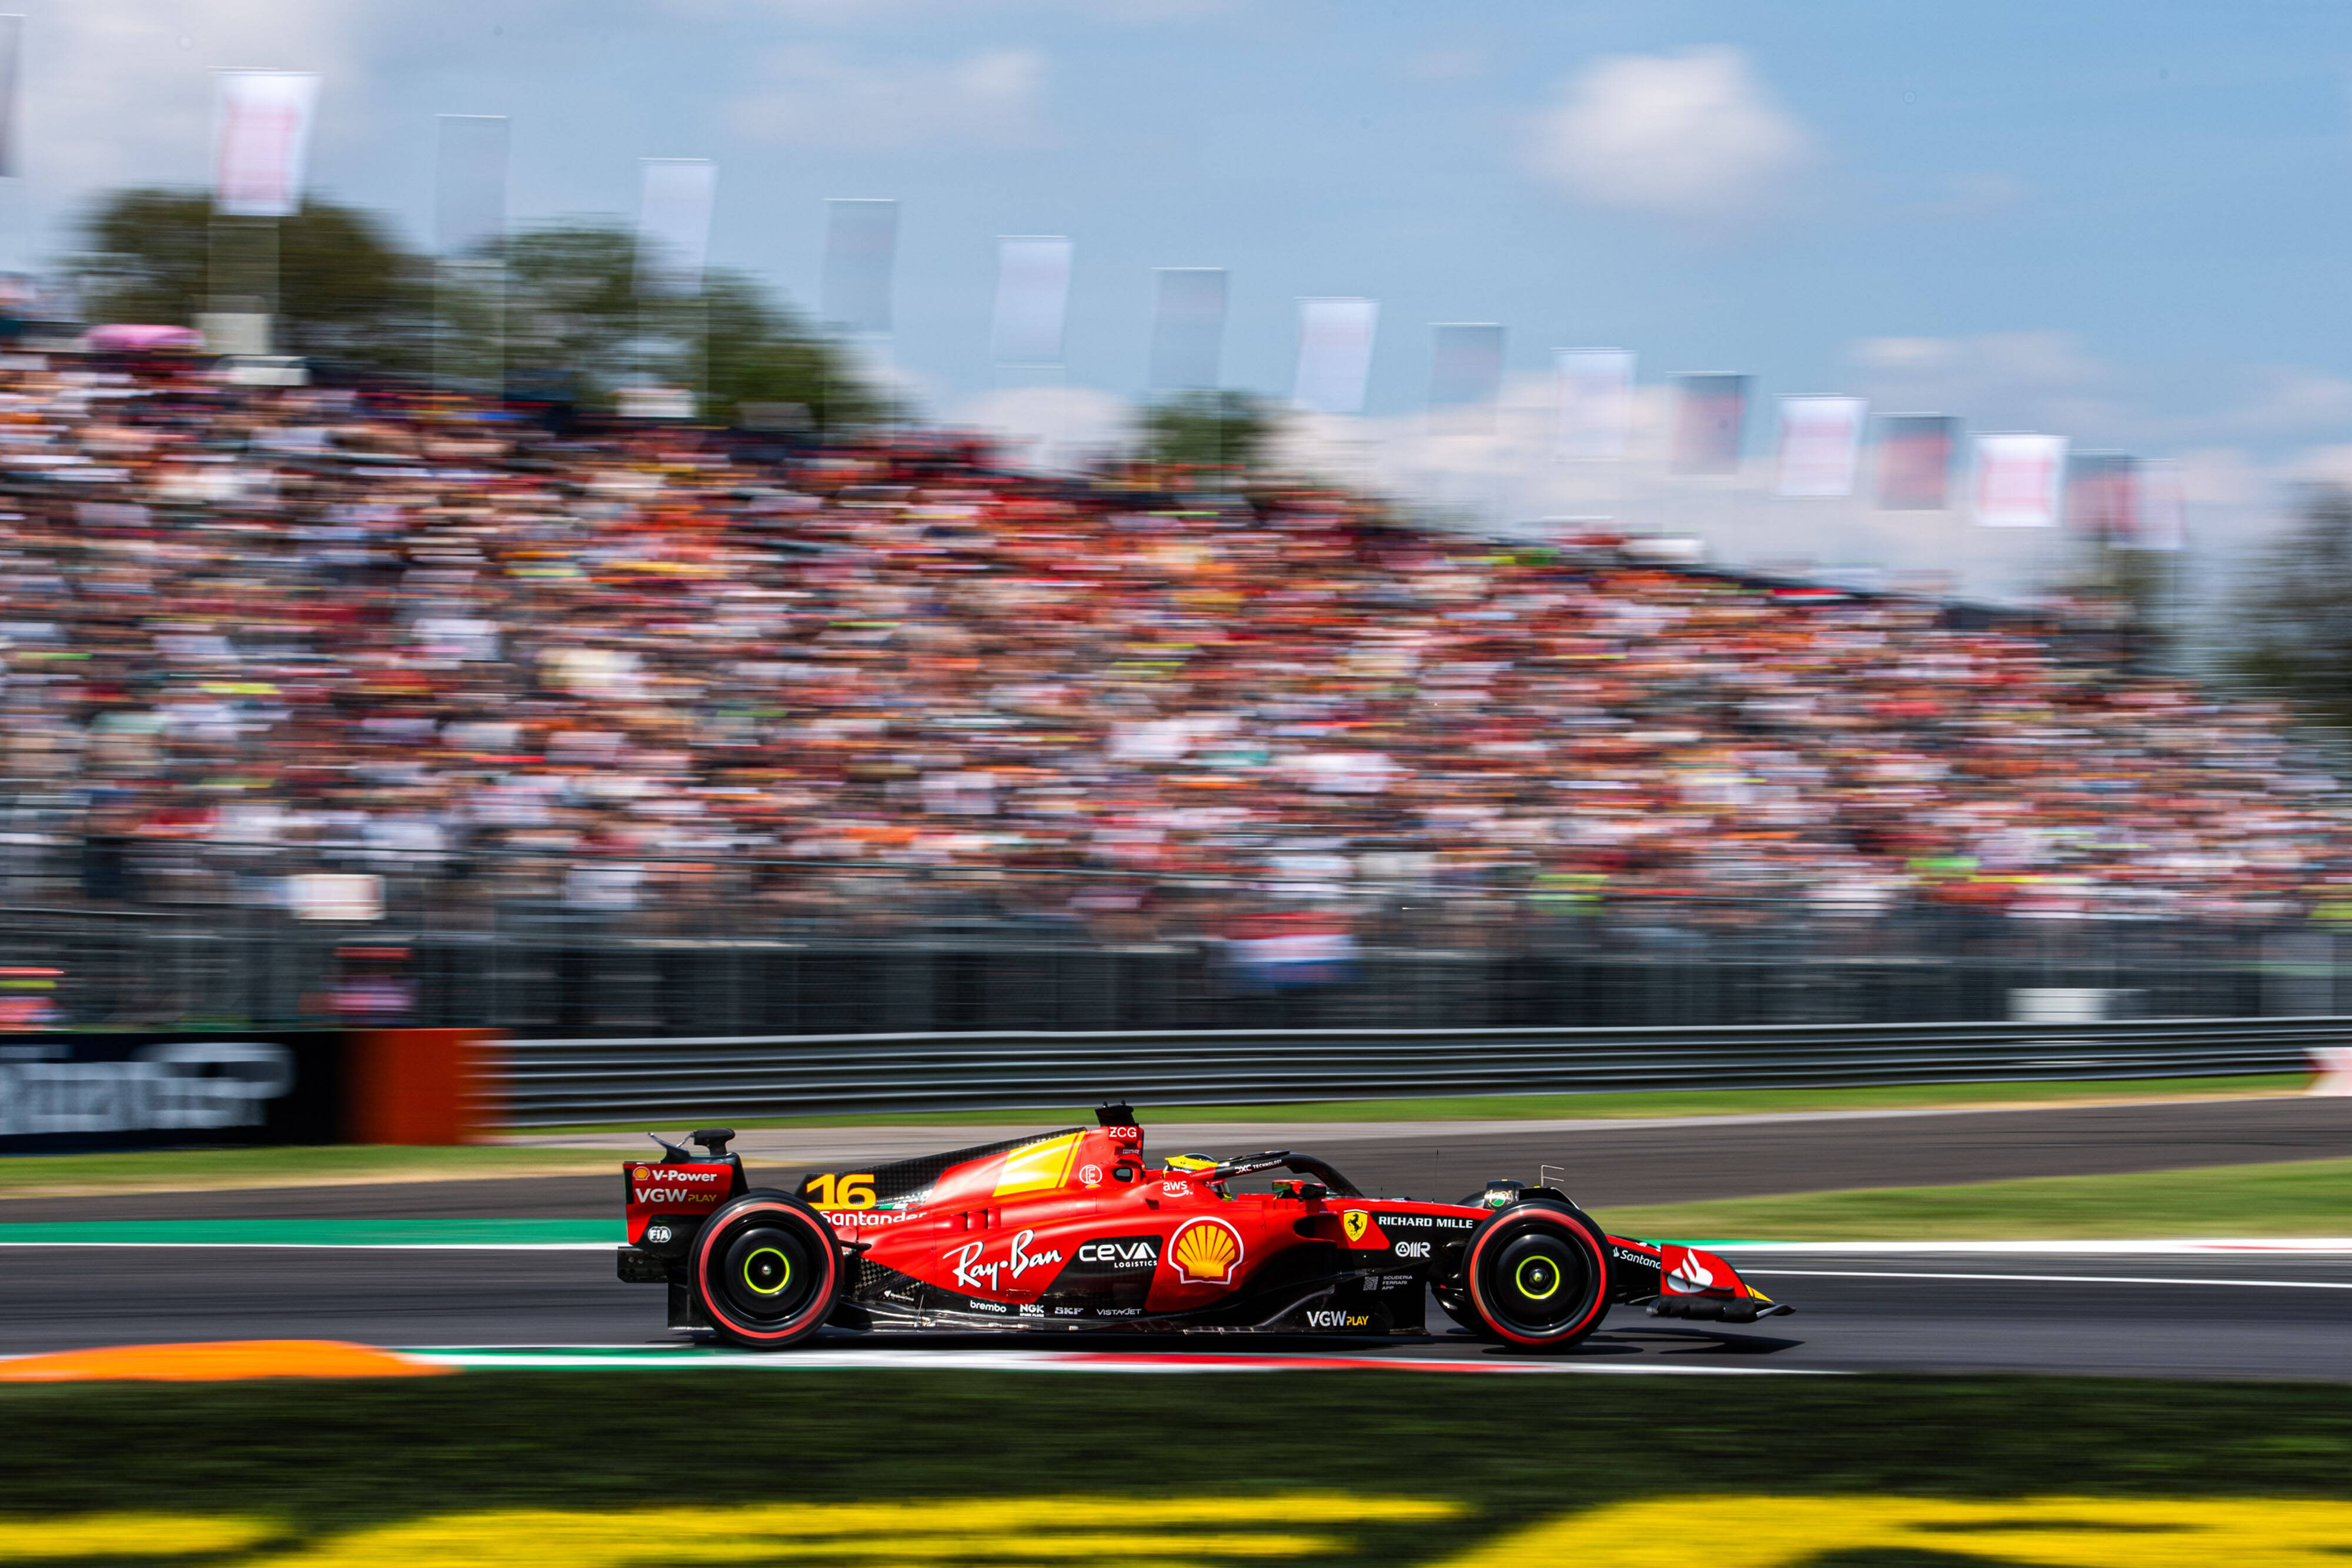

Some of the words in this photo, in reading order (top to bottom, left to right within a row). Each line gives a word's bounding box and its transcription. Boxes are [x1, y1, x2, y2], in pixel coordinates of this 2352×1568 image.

[1109, 1127, 1137, 1138] ZCG
[1252, 1159, 1282, 1169] TECHNOLOGY
[652, 1170, 717, 1181] V-Power
[806, 1173, 877, 1211] 16
[1163, 1181, 1188, 1191] aws
[635, 1188, 687, 1203] VGW
[687, 1194, 717, 1202] PLAY
[820, 1211, 927, 1226] Santander
[1379, 1216, 1432, 1227] RICHARD
[1436, 1218, 1474, 1229] MILLE
[649, 1229, 670, 1241] FIA
[942, 1229, 1063, 1290] Ray-Ban
[1114, 1260, 1158, 1268] LOGISTICS
[970, 1300, 1007, 1313] brembo
[1020, 1303, 1044, 1313] NGK
[1054, 1306, 1084, 1315] SKF
[1307, 1310, 1347, 1327] VGW
[1347, 1315, 1369, 1326] PLAY
